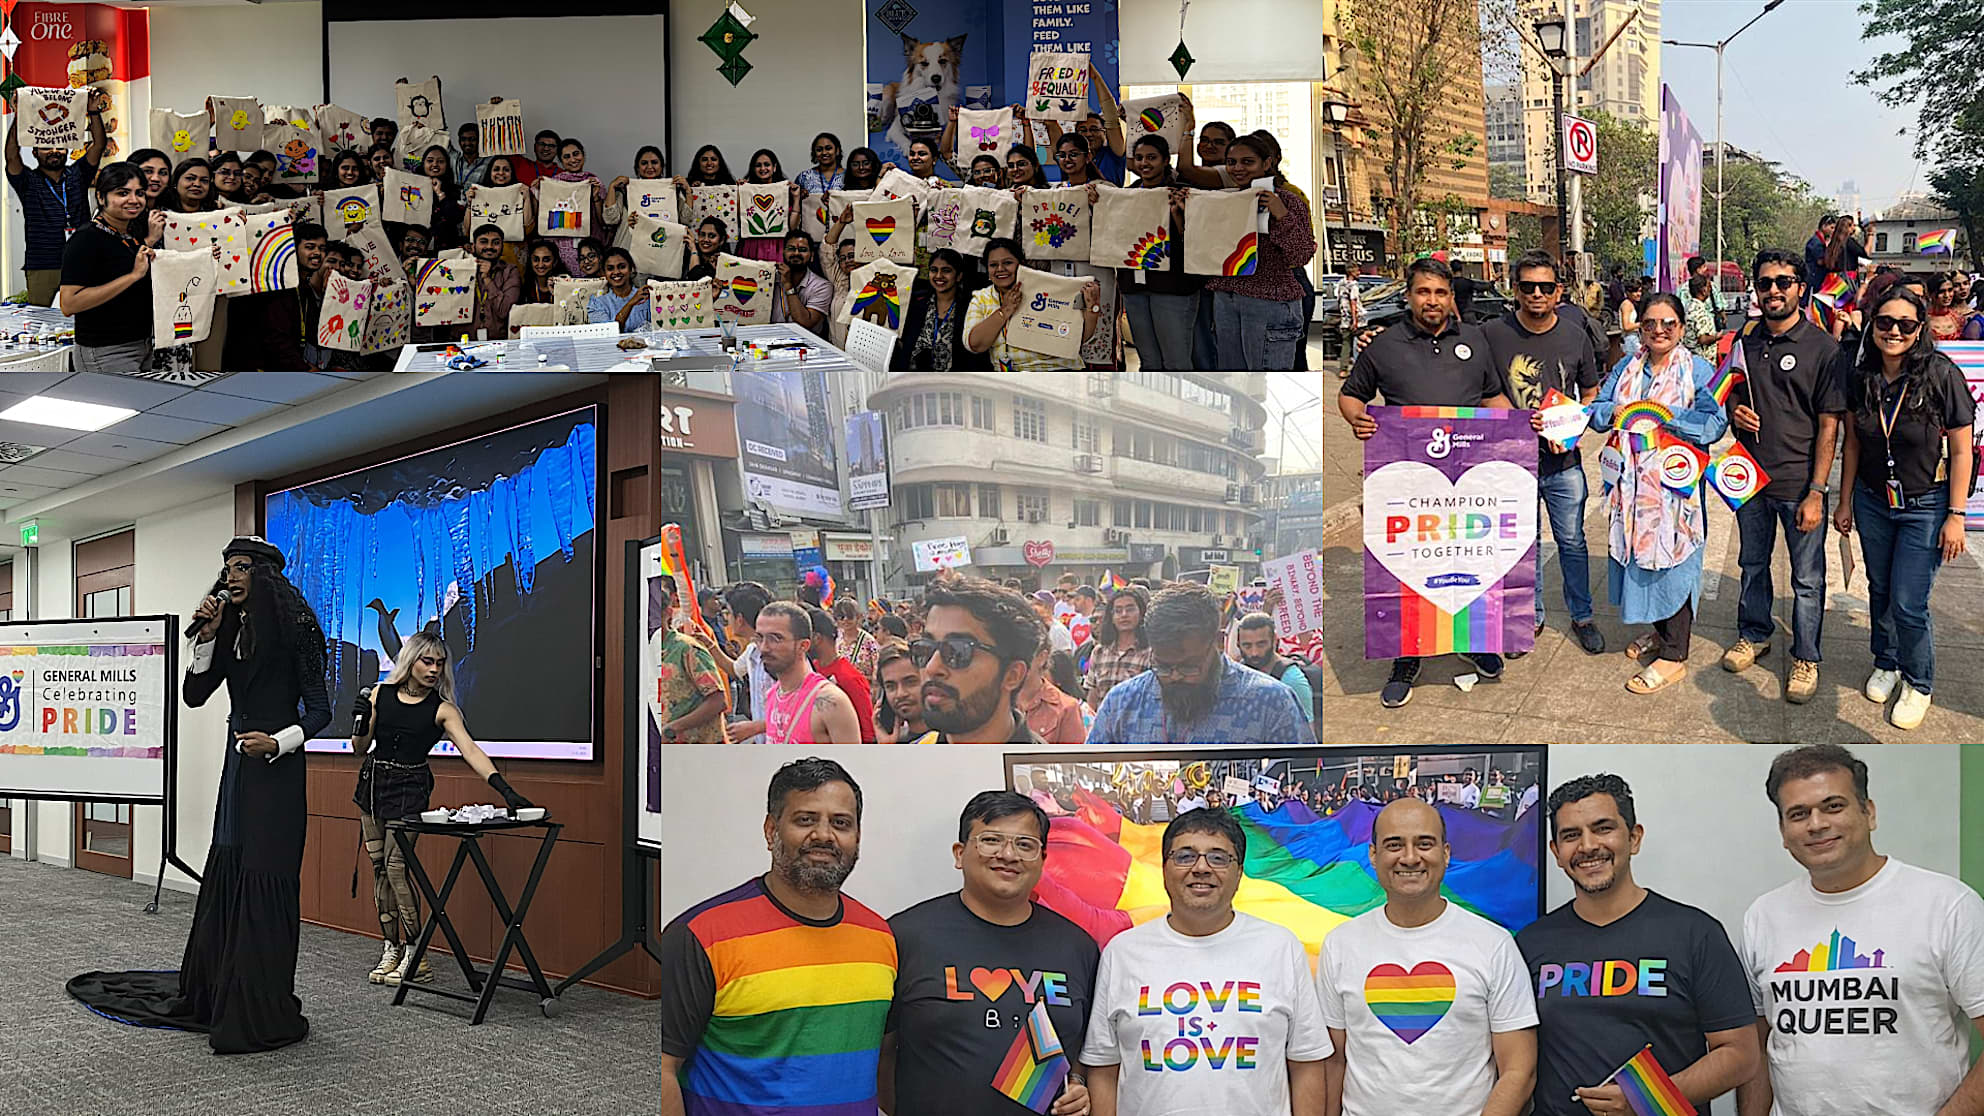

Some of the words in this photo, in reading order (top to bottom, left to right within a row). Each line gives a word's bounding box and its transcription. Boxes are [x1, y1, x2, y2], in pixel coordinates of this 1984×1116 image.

[34, 11, 69, 23] FIBRE
[1033, 5, 1063, 15] THEM
[1066, 4, 1091, 14] LIKE
[1033, 17, 1074, 28] FAMILY.
[31, 22, 73, 40] One
[1033, 30, 1060, 40] FEED
[1067, 42, 1091, 52] LIKE
[1039, 66, 1087, 81] FREEDOM
[42, 94, 73, 103] BELONG
[27, 121, 77, 136] STRONGER
[481, 115, 522, 138] HUMAN
[34, 133, 79, 144] TOGETHER
[1032, 201, 1081, 218] PRIDE!
[1452, 433, 1485, 441] General
[1408, 497, 1498, 509] CHAMPION
[1386, 513, 1518, 544] PRIDE
[1411, 546, 1494, 559] TOGETHER
[1303, 553, 1319, 595] BEYOND
[1312, 597, 1323, 619] THE
[43, 670, 97, 682] GENERAL
[100, 669, 137, 682] MILLS
[43, 688, 137, 705] Celebrating
[42, 707, 137, 735] PRIDE
[1538, 959, 1668, 998] PRIDE
[1770, 976, 1899, 1003] MUMBAI
[1138, 981, 1262, 1016] LOVE
[1178, 1016, 1203, 1037] IS
[1776, 1007, 1899, 1036] QUEER
[1141, 1037, 1259, 1072] LOVE
